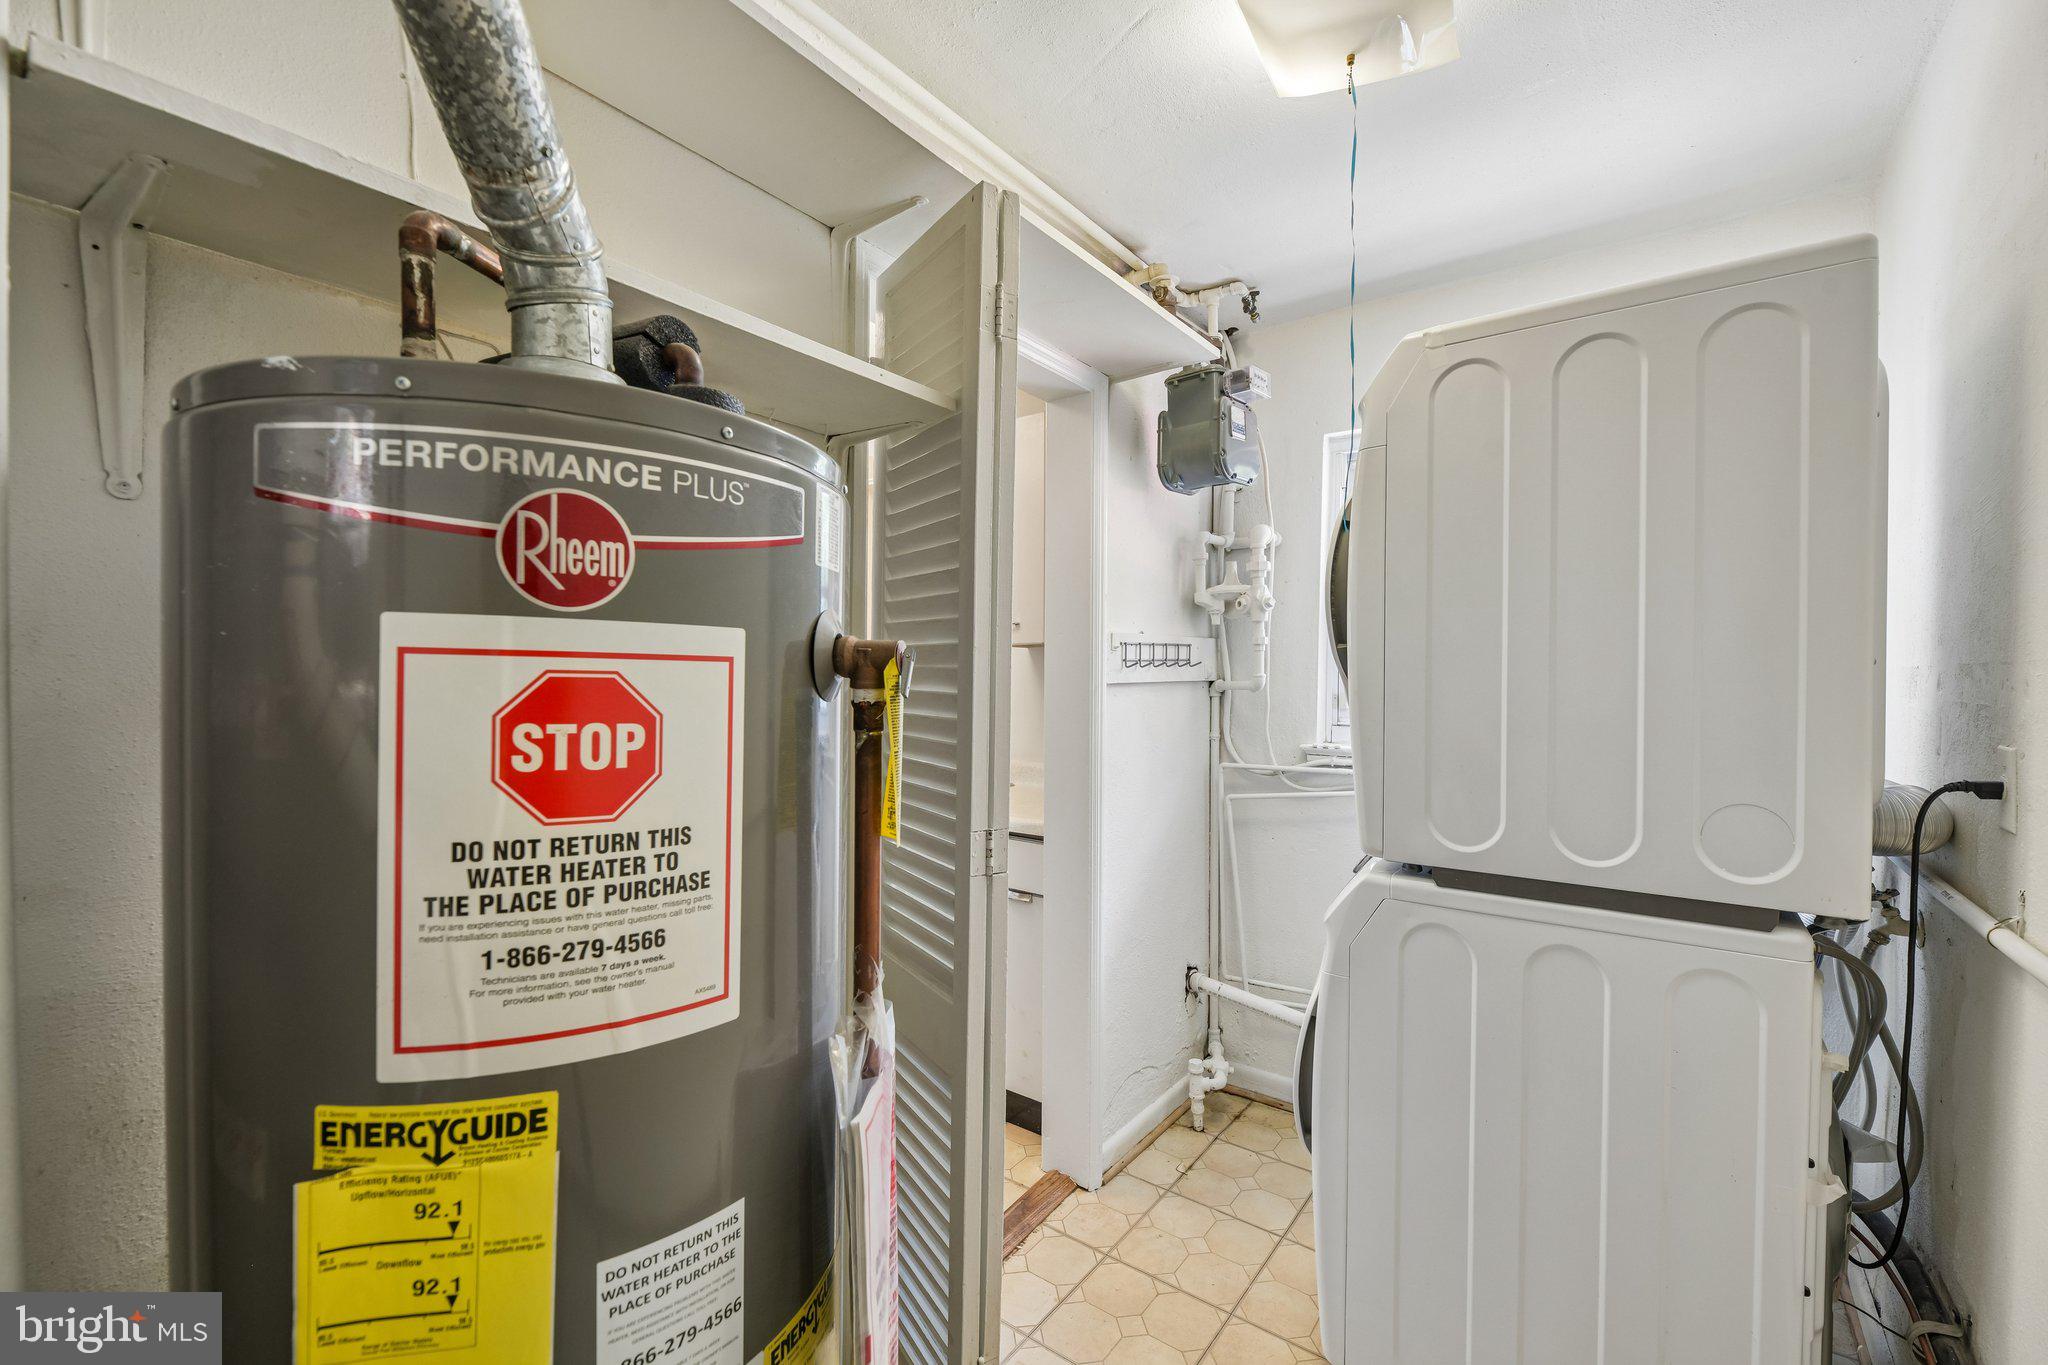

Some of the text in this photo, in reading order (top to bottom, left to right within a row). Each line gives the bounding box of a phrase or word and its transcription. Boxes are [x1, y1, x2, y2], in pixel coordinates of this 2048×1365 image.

[352, 437, 744, 505] PERFORMANCE PLUS
[516, 493, 625, 591] Rheem
[510, 722, 646, 773] STOP
[451, 825, 692, 863] DO NOT RETURN THIS
[467, 851, 679, 889] WATER HEATER TO
[423, 870, 710, 918] THE PLACE OF PURCHASE
[419, 934, 443, 943] need
[445, 931, 499, 943] installation
[501, 925, 552, 938] assistance
[555, 926, 564, 934] or
[567, 923, 590, 932] have
[592, 917, 625, 931] general
[627, 911, 667, 924] questions
[669, 908, 682, 917] call
[684, 906, 695, 915] toll
[429, 924, 445, 933] you
[467, 917, 529, 931] experiencing
[532, 915, 561, 924] issues
[565, 912, 584, 922] with
[587, 910, 602, 919] this
[605, 908, 628, 917] water
[662, 898, 691, 908] missing
[481, 928, 666, 970] 1-866-279-4566
[469, 989, 486, 998] For
[488, 987, 513, 996] more
[574, 978, 591, 986] see
[594, 975, 608, 983] the
[645, 961, 675, 974] manual
[481, 974, 537, 986] Technicians
[540, 972, 555, 980] are
[558, 965, 598, 978] available
[601, 963, 607, 971] 7
[609, 960, 631, 971] days
[502, 994, 545, 1008] provided
[547, 991, 566, 1000] with
[569, 988, 589, 1000] your
[592, 985, 615, 994] water
[321, 1107, 549, 1167] ENERGYGUIDE
[391, 1174, 422, 1184] Rating
[414, 1200, 462, 1220] 92.1
[601, 1227, 741, 1302] WATER HEATER TO THE
[605, 1213, 739, 1283] DO NOT RETURN THIS
[413, 1276, 461, 1297] 92.1
[609, 1291, 651, 1319] PLACE
[655, 1282, 673, 1299] OF
[676, 1247, 736, 1290] PURCHASE
